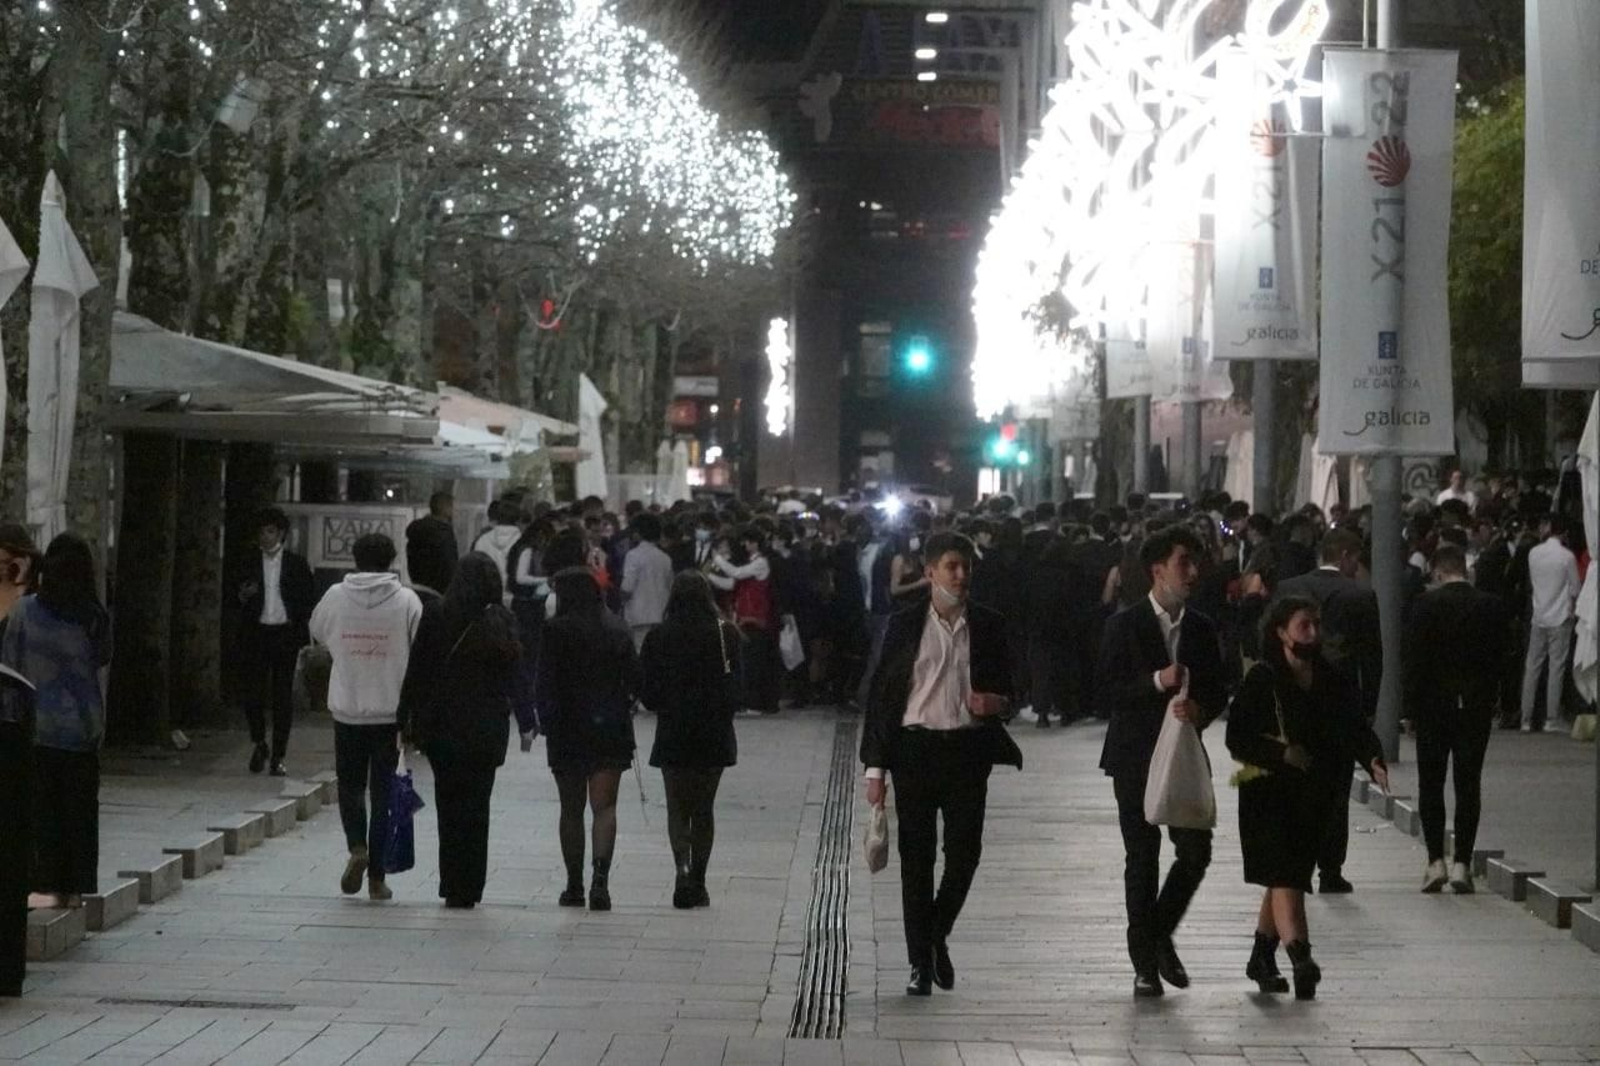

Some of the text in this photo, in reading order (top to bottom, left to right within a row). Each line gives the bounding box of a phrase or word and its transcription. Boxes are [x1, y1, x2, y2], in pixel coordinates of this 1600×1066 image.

[1371, 197, 1406, 284] X21
[1231, 323, 1299, 347] galicia
[1352, 379, 1371, 389] DE
[1343, 405, 1431, 436] galicia
